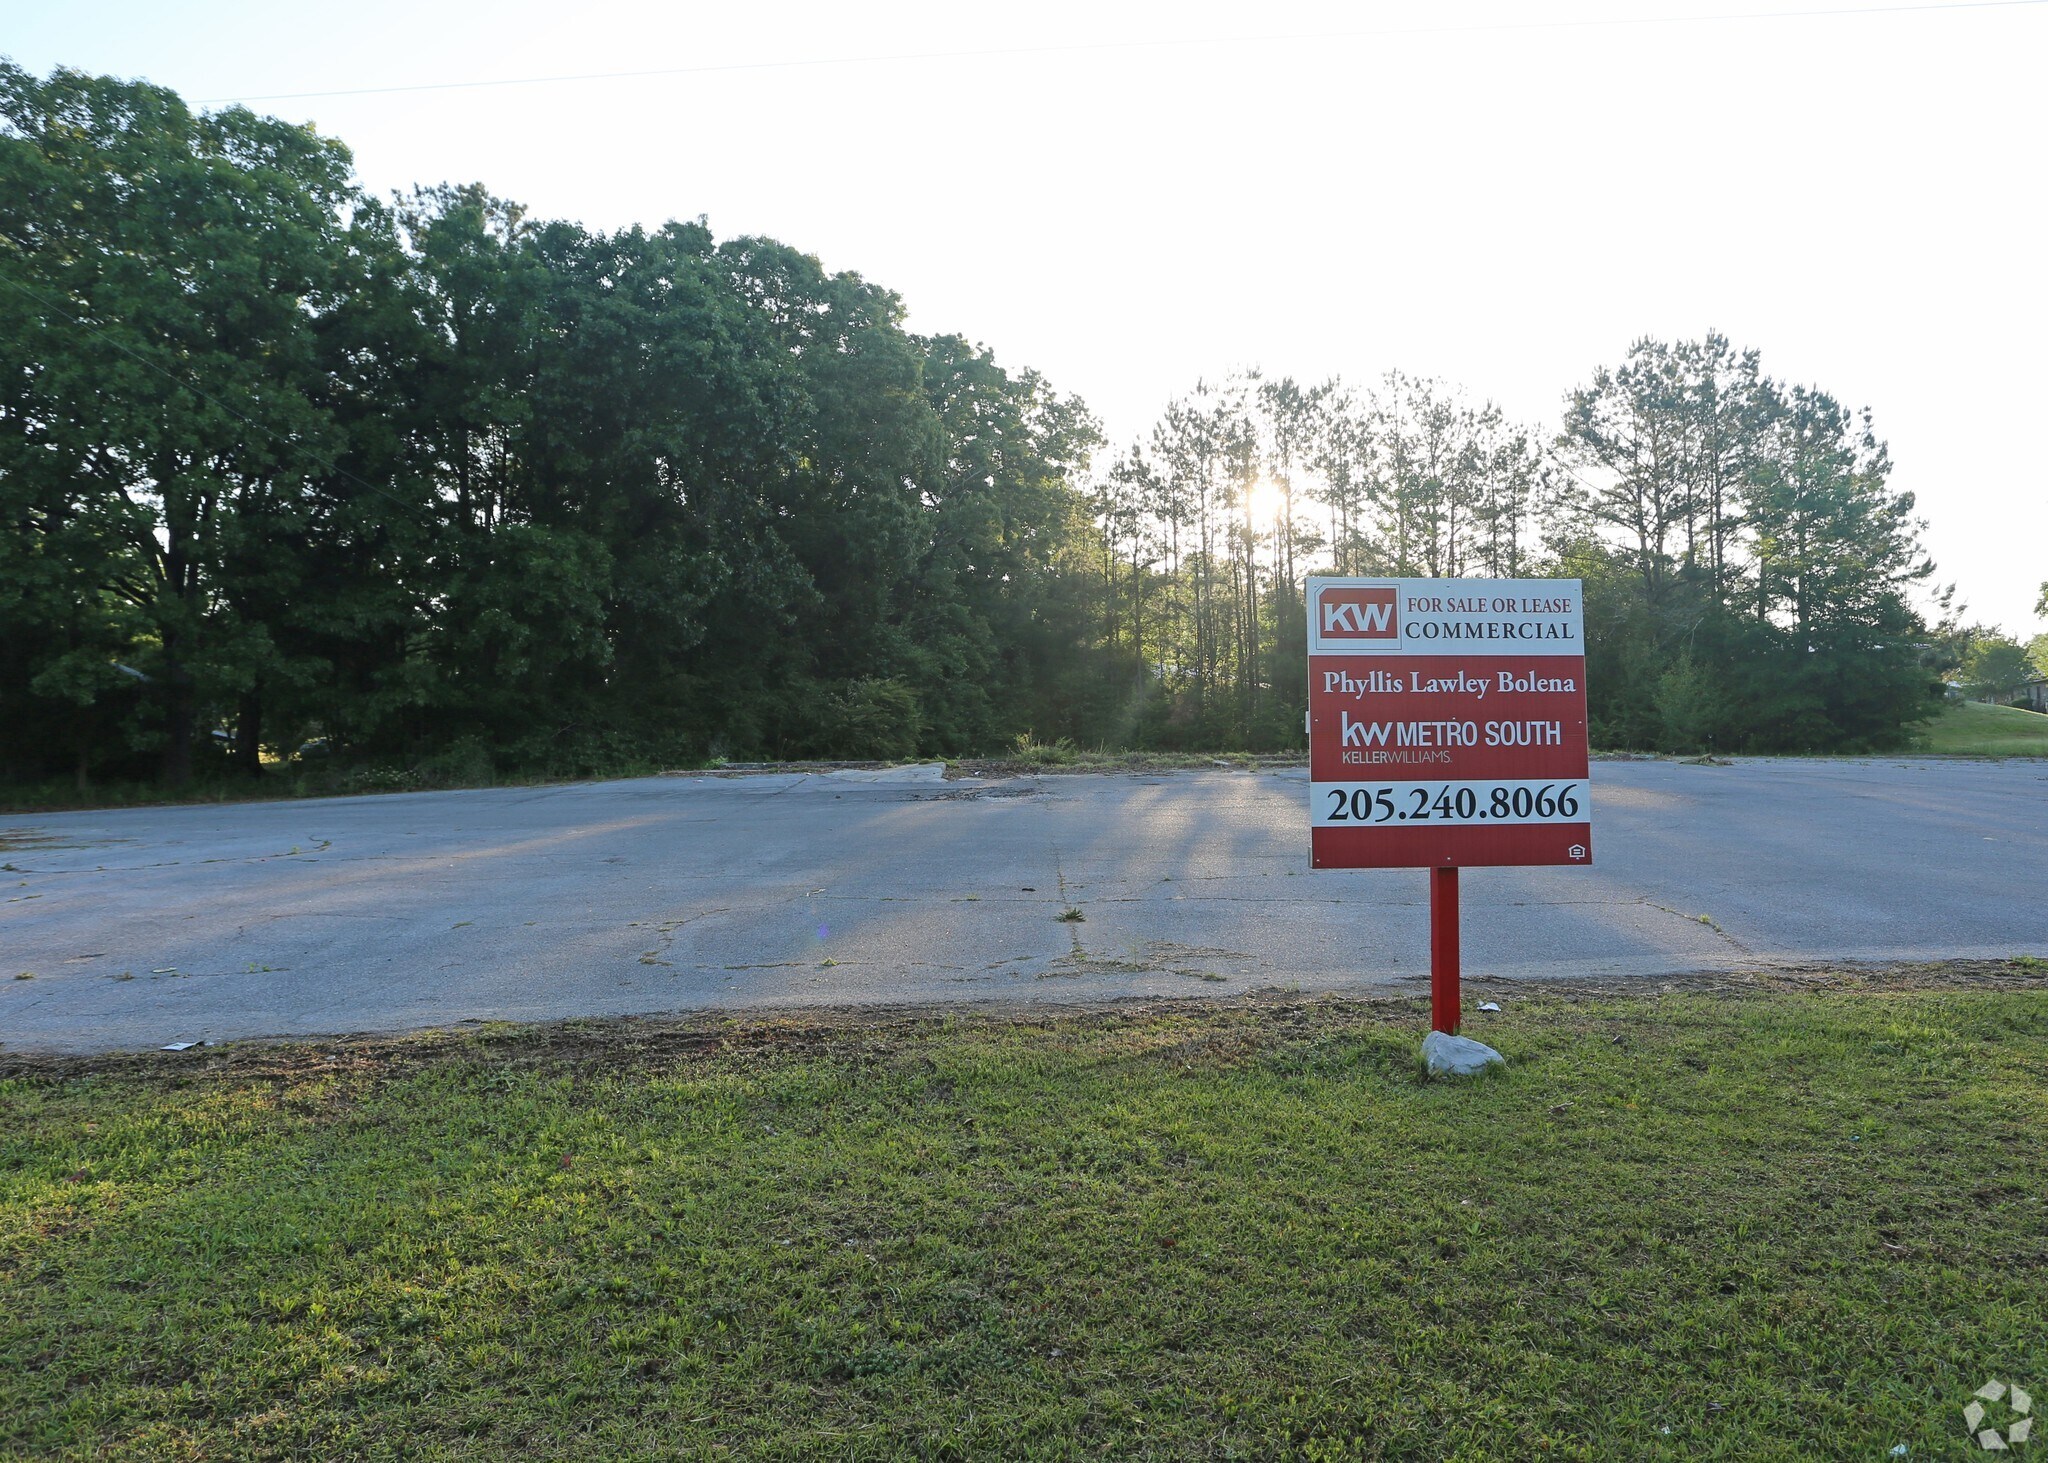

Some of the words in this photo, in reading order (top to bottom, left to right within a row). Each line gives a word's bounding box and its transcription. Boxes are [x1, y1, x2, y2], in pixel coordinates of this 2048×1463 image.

[1323, 603, 1393, 632] KW
[1407, 597, 1443, 613] FOR
[1446, 597, 1488, 613] SALE
[1491, 597, 1517, 613] OR
[1521, 598, 1572, 613] LEASE
[1405, 622, 1574, 639] COMMERCIAL
[1323, 670, 1403, 699] Phyllis
[1410, 670, 1491, 699] Lawley
[1497, 670, 1576, 693] Bolena
[1341, 710, 1393, 747] kw
[1397, 720, 1478, 747] METRO
[1484, 720, 1561, 746] SOUTH
[1327, 784, 1579, 822] 205.240.8066
